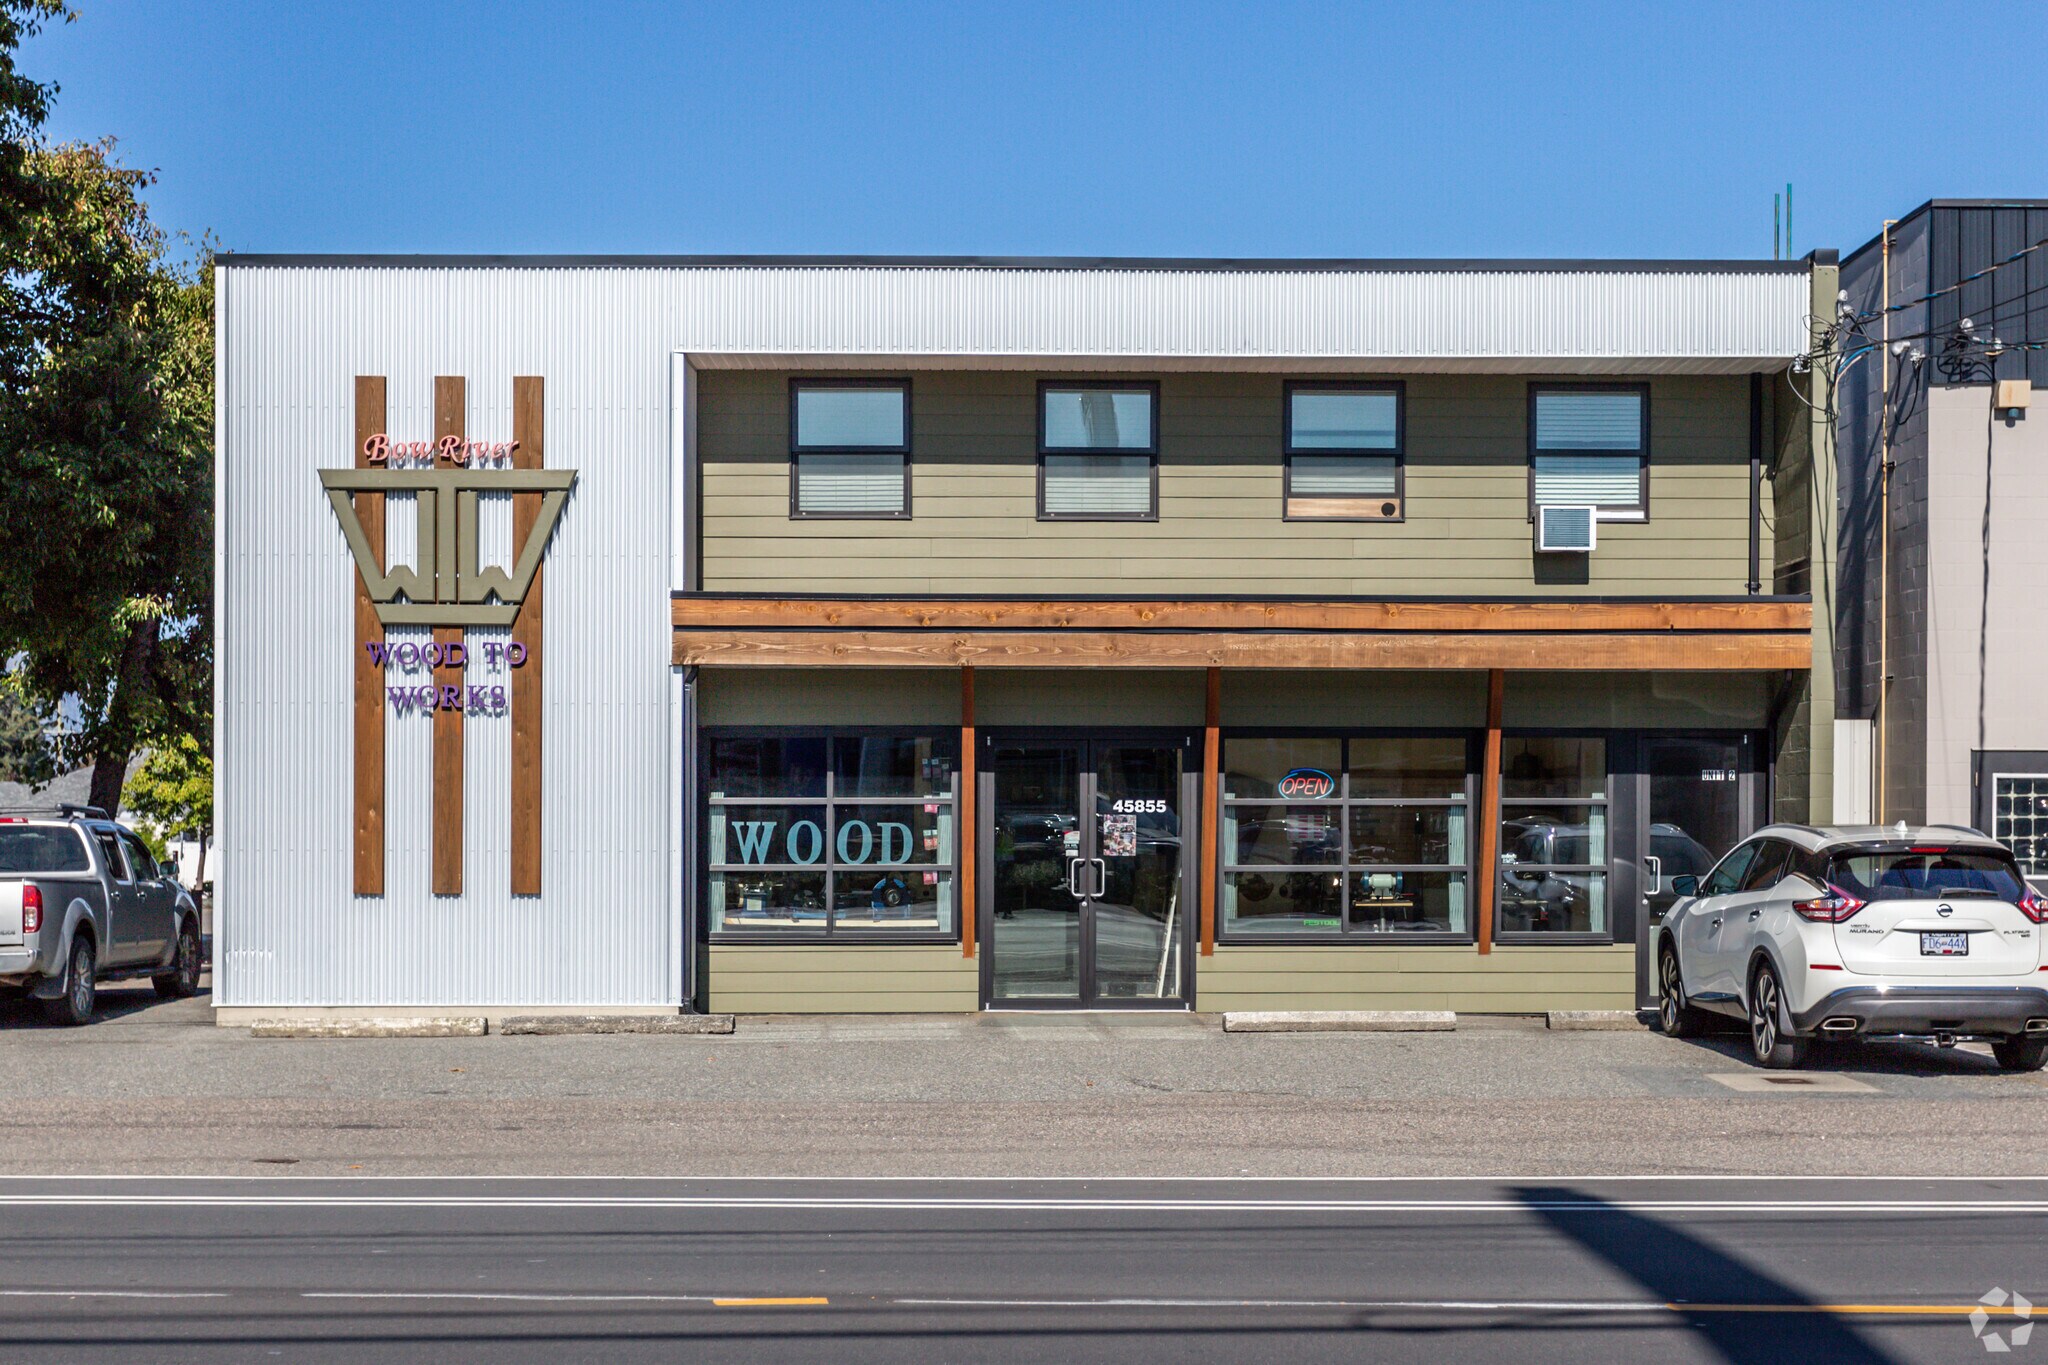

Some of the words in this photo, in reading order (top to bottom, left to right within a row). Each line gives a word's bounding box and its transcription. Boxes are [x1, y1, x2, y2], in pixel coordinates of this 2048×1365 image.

[364, 433, 435, 461] Bow
[439, 435, 520, 463] River
[365, 641, 468, 666] WOOD
[482, 641, 528, 665] TO
[385, 684, 507, 709] WORKS
[1281, 777, 1329, 795] OPEN
[1702, 769, 1725, 780] UNIT
[1729, 769, 1736, 780] 2
[1112, 799, 1167, 813] 45855
[731, 819, 914, 865] WOOD
